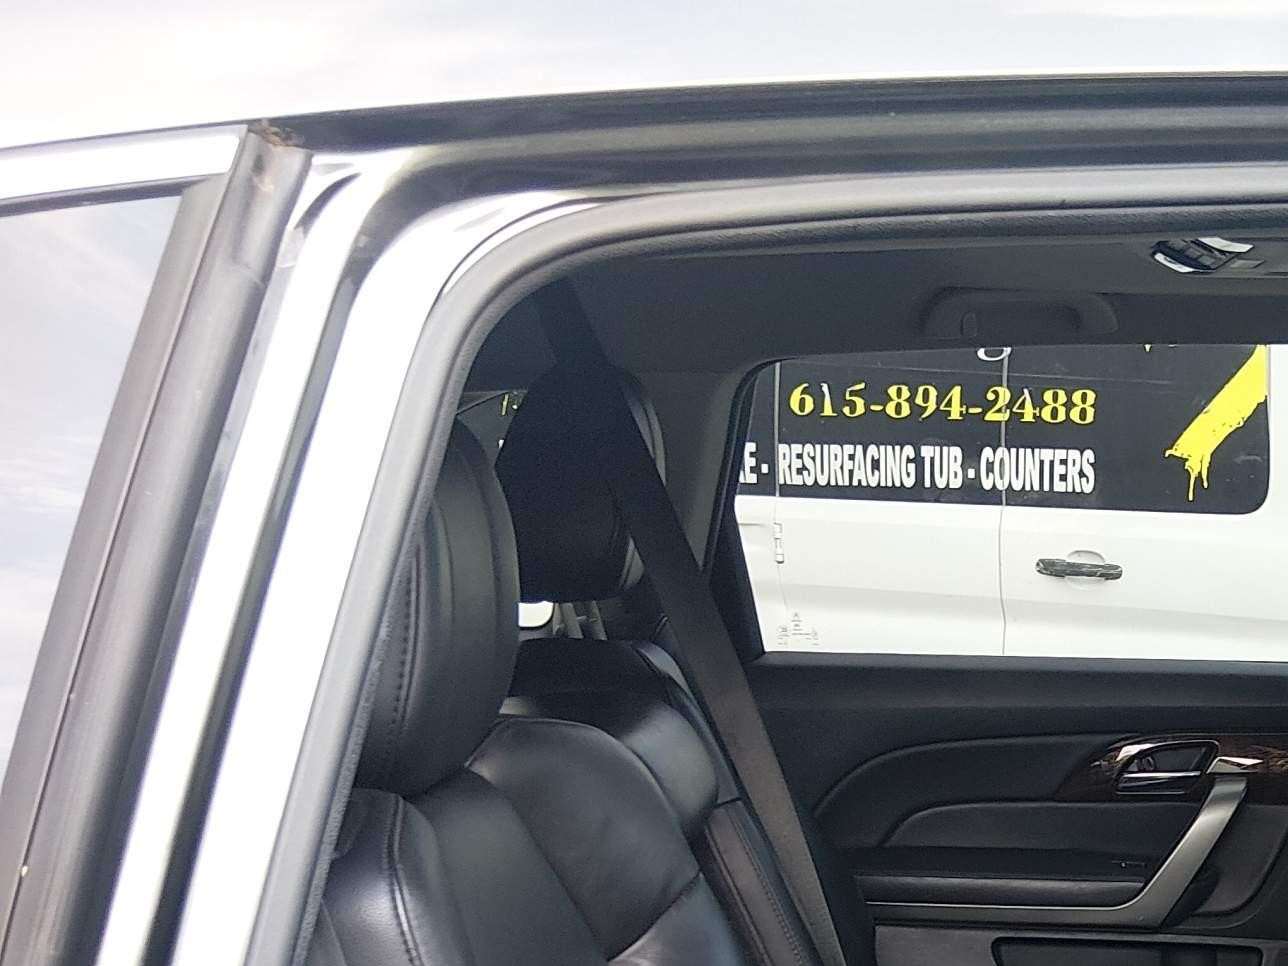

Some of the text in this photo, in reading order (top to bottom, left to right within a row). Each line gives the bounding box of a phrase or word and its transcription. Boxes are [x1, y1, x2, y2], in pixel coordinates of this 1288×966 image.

[789, 382, 1097, 425] 615-894-2488
[739, 442, 758, 484] E
[778, 443, 916, 488] RESURFACING
[920, 445, 963, 489] TUB
[980, 446, 1095, 494] COUNTERS
